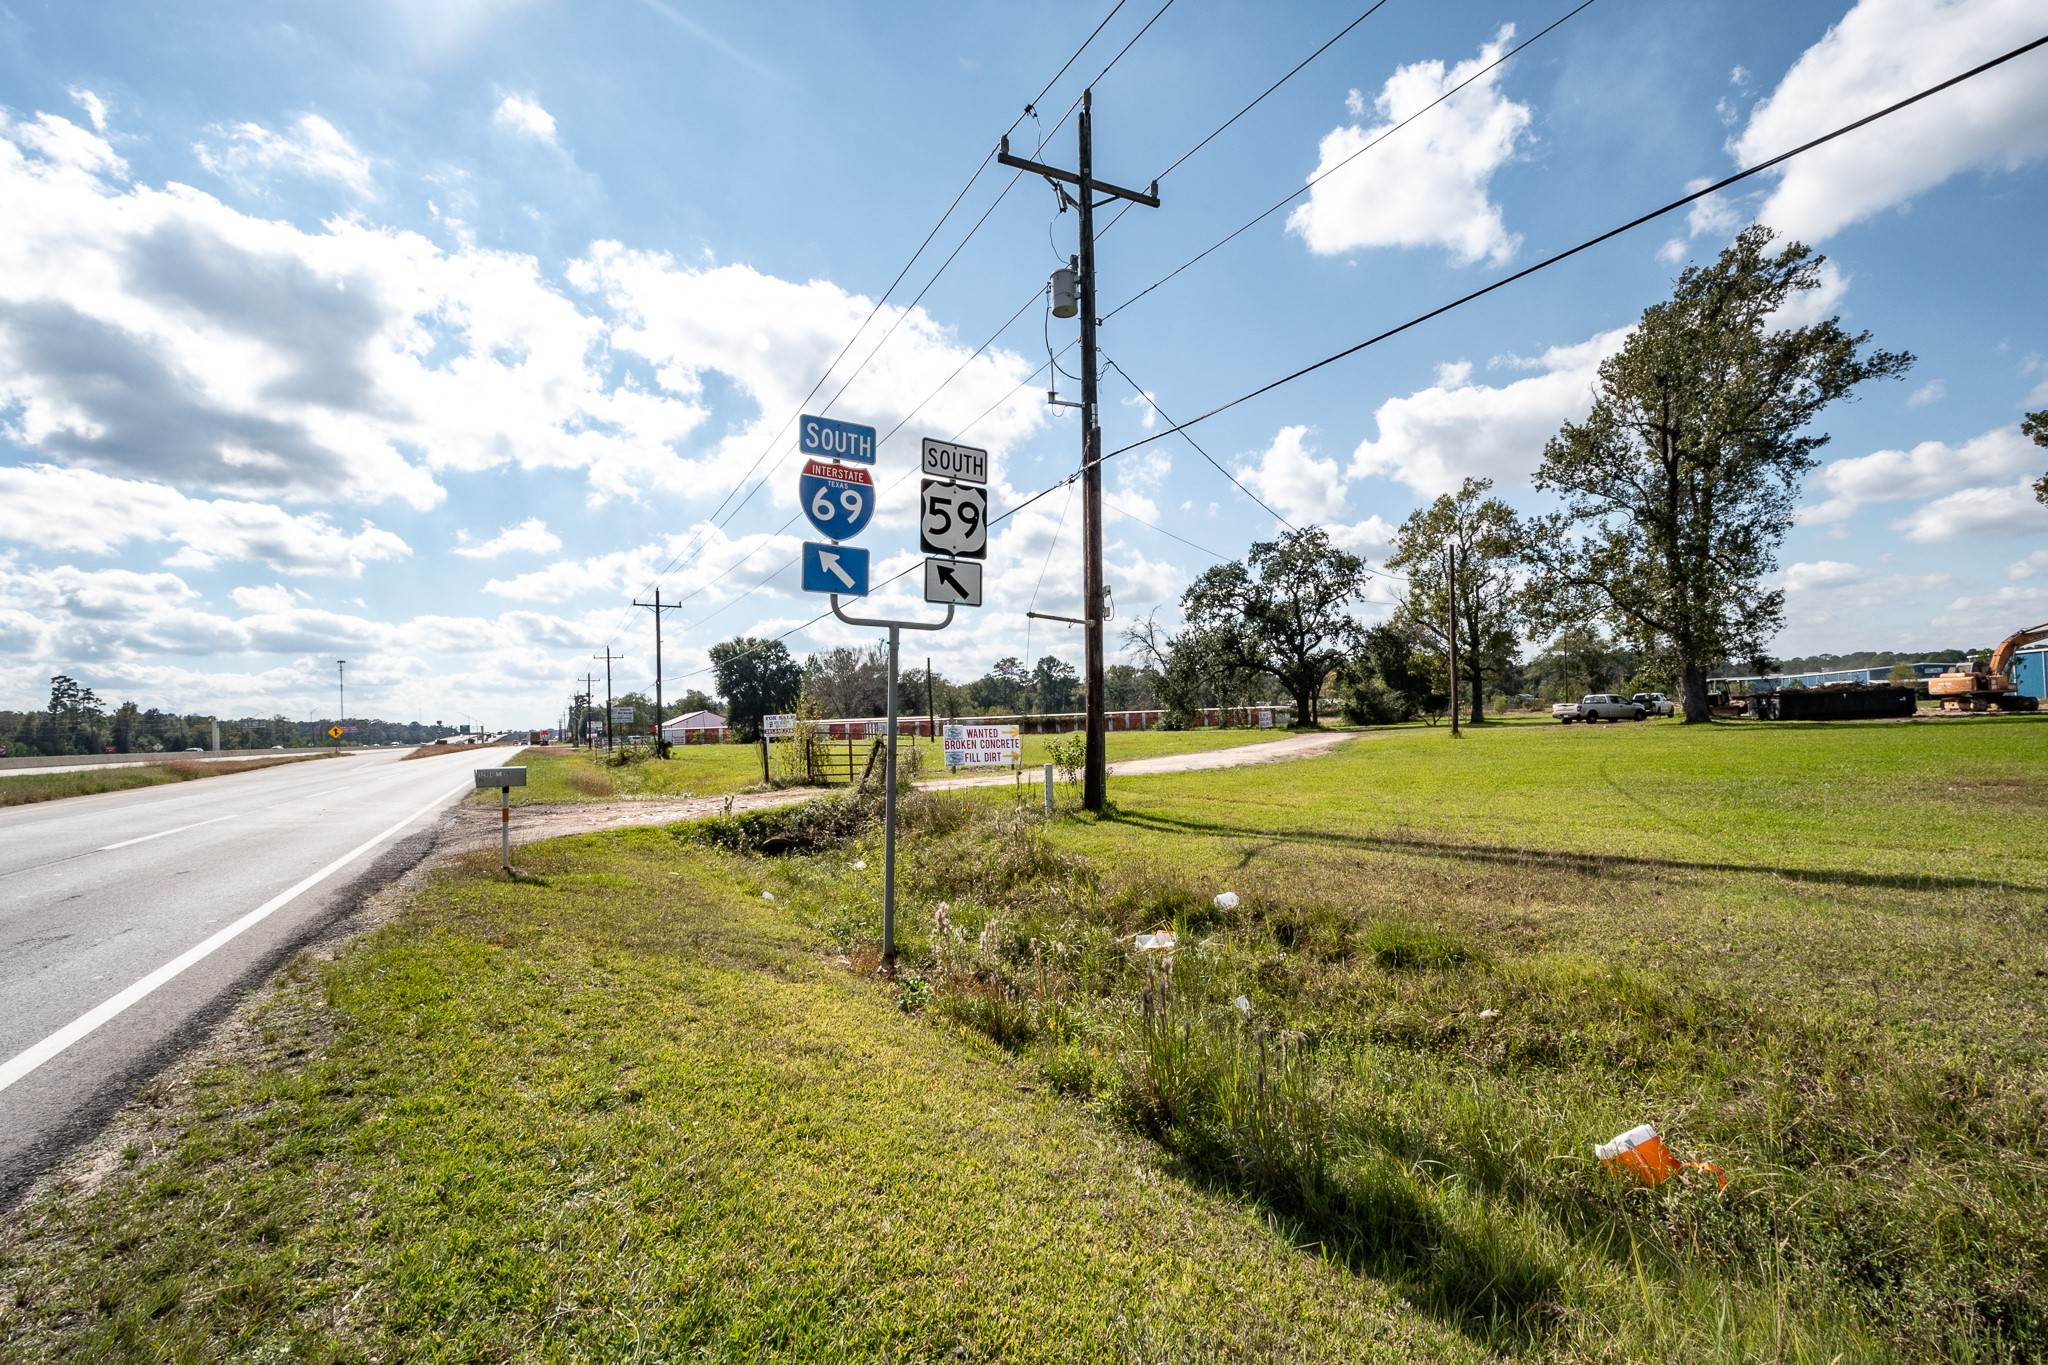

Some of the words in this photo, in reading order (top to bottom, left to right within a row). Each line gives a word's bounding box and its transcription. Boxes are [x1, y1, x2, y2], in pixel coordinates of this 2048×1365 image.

[805, 422, 871, 458] SOUTH
[927, 447, 984, 477] SOUTH
[812, 464, 864, 482] INTERSTATE
[828, 480, 849, 490] TEXAS
[811, 486, 863, 524] 69
[928, 496, 980, 540] 59
[966, 728, 999, 739] WANTED
[944, 740, 977, 750] BROKEN
[980, 738, 1020, 749] CONCRETE
[964, 752, 981, 763] FILL
[984, 751, 1002, 762] DIRT
